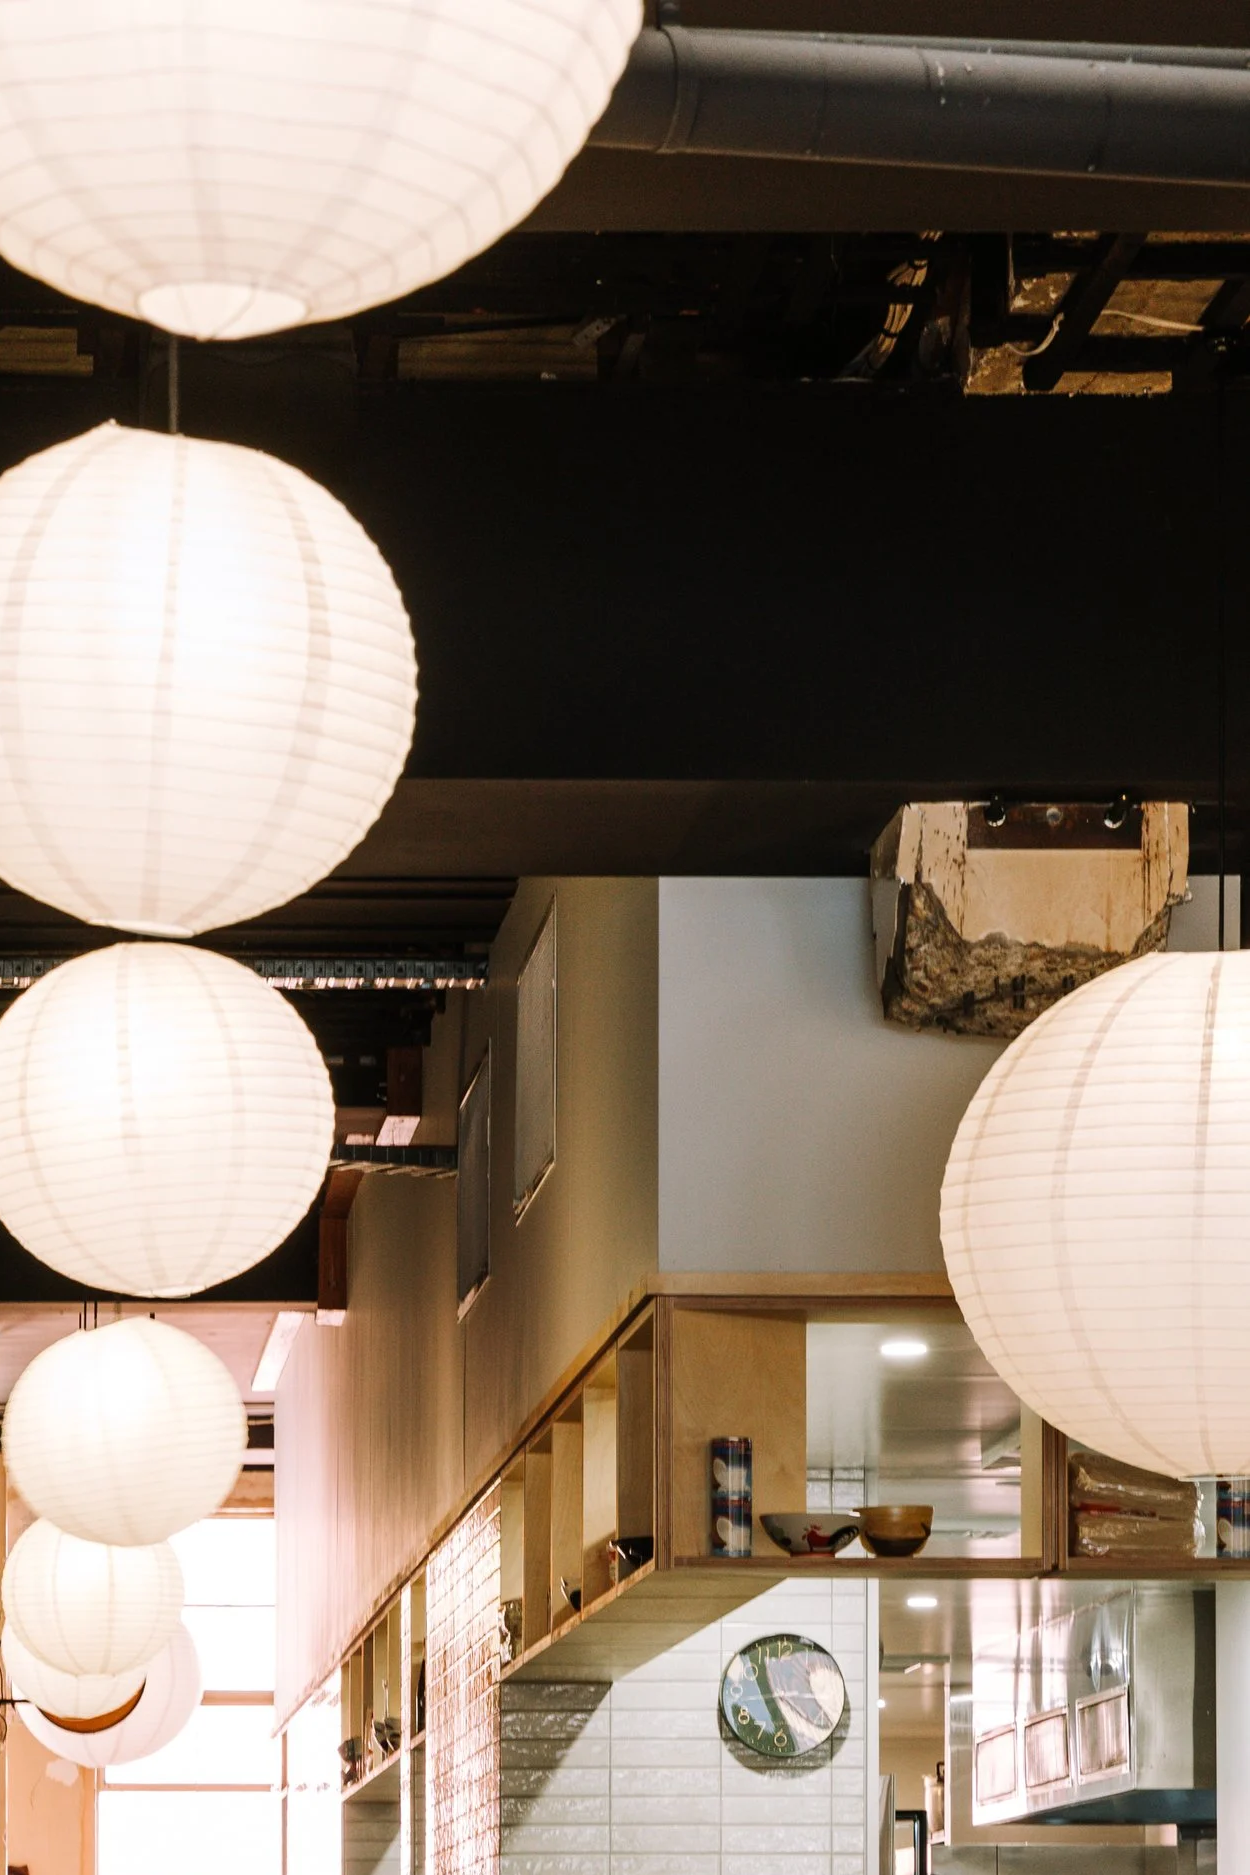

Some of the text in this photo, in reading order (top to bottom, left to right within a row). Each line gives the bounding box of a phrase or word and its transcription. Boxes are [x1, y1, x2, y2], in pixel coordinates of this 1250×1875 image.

[777, 1640, 793, 1660] 12
[738, 1706, 750, 1724] 8
[753, 1720, 766, 1740] 7
[774, 1728, 787, 1747] 6
